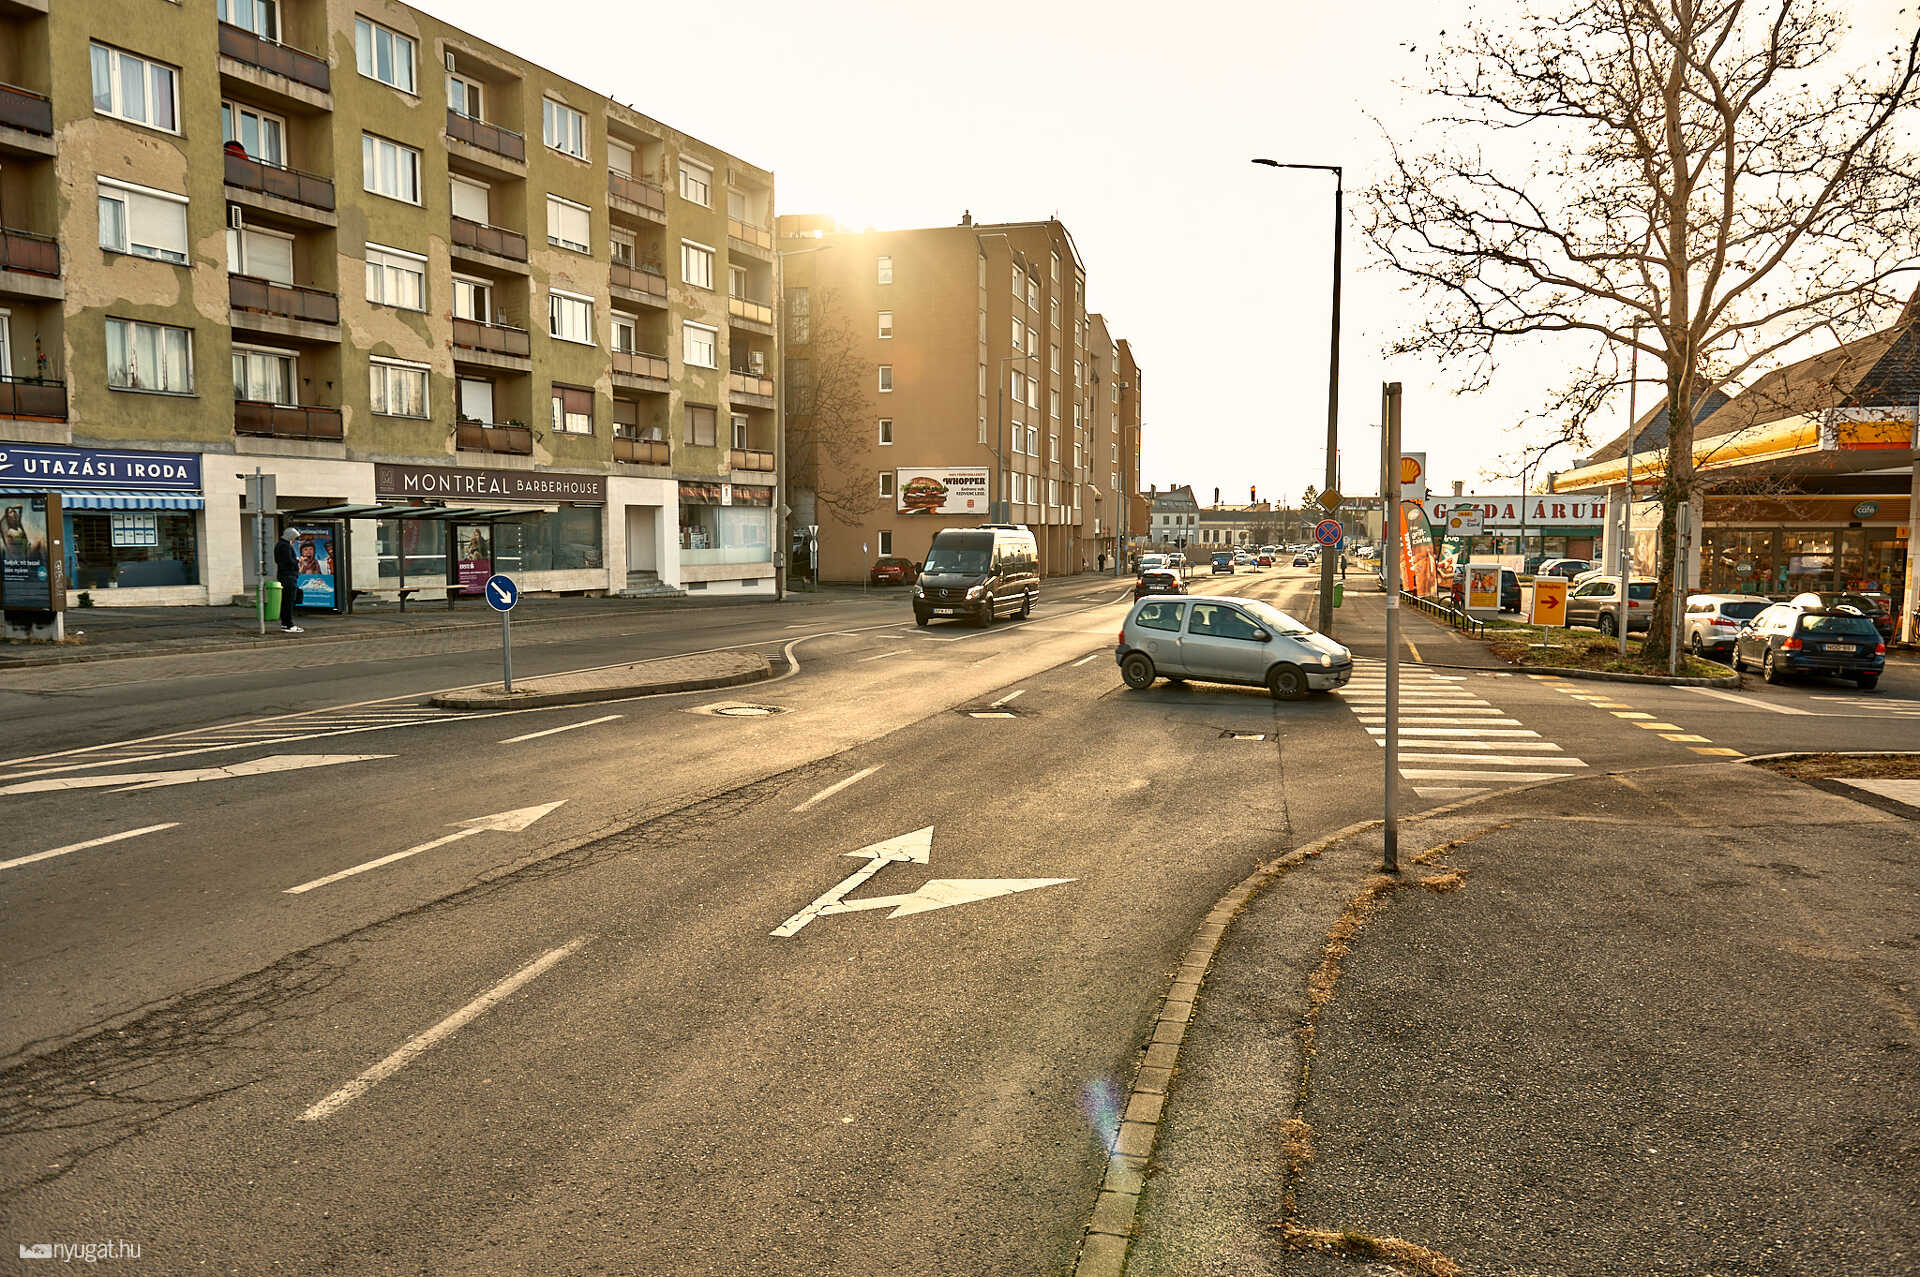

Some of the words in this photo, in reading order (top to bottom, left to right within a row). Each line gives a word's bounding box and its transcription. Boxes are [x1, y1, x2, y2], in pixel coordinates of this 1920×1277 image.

[24, 458, 115, 476] UTAZÁSI
[127, 463, 187, 478] IRODA
[404, 472, 510, 494] MONTRÉAL
[516, 479, 599, 494] BARBERHOUSE
